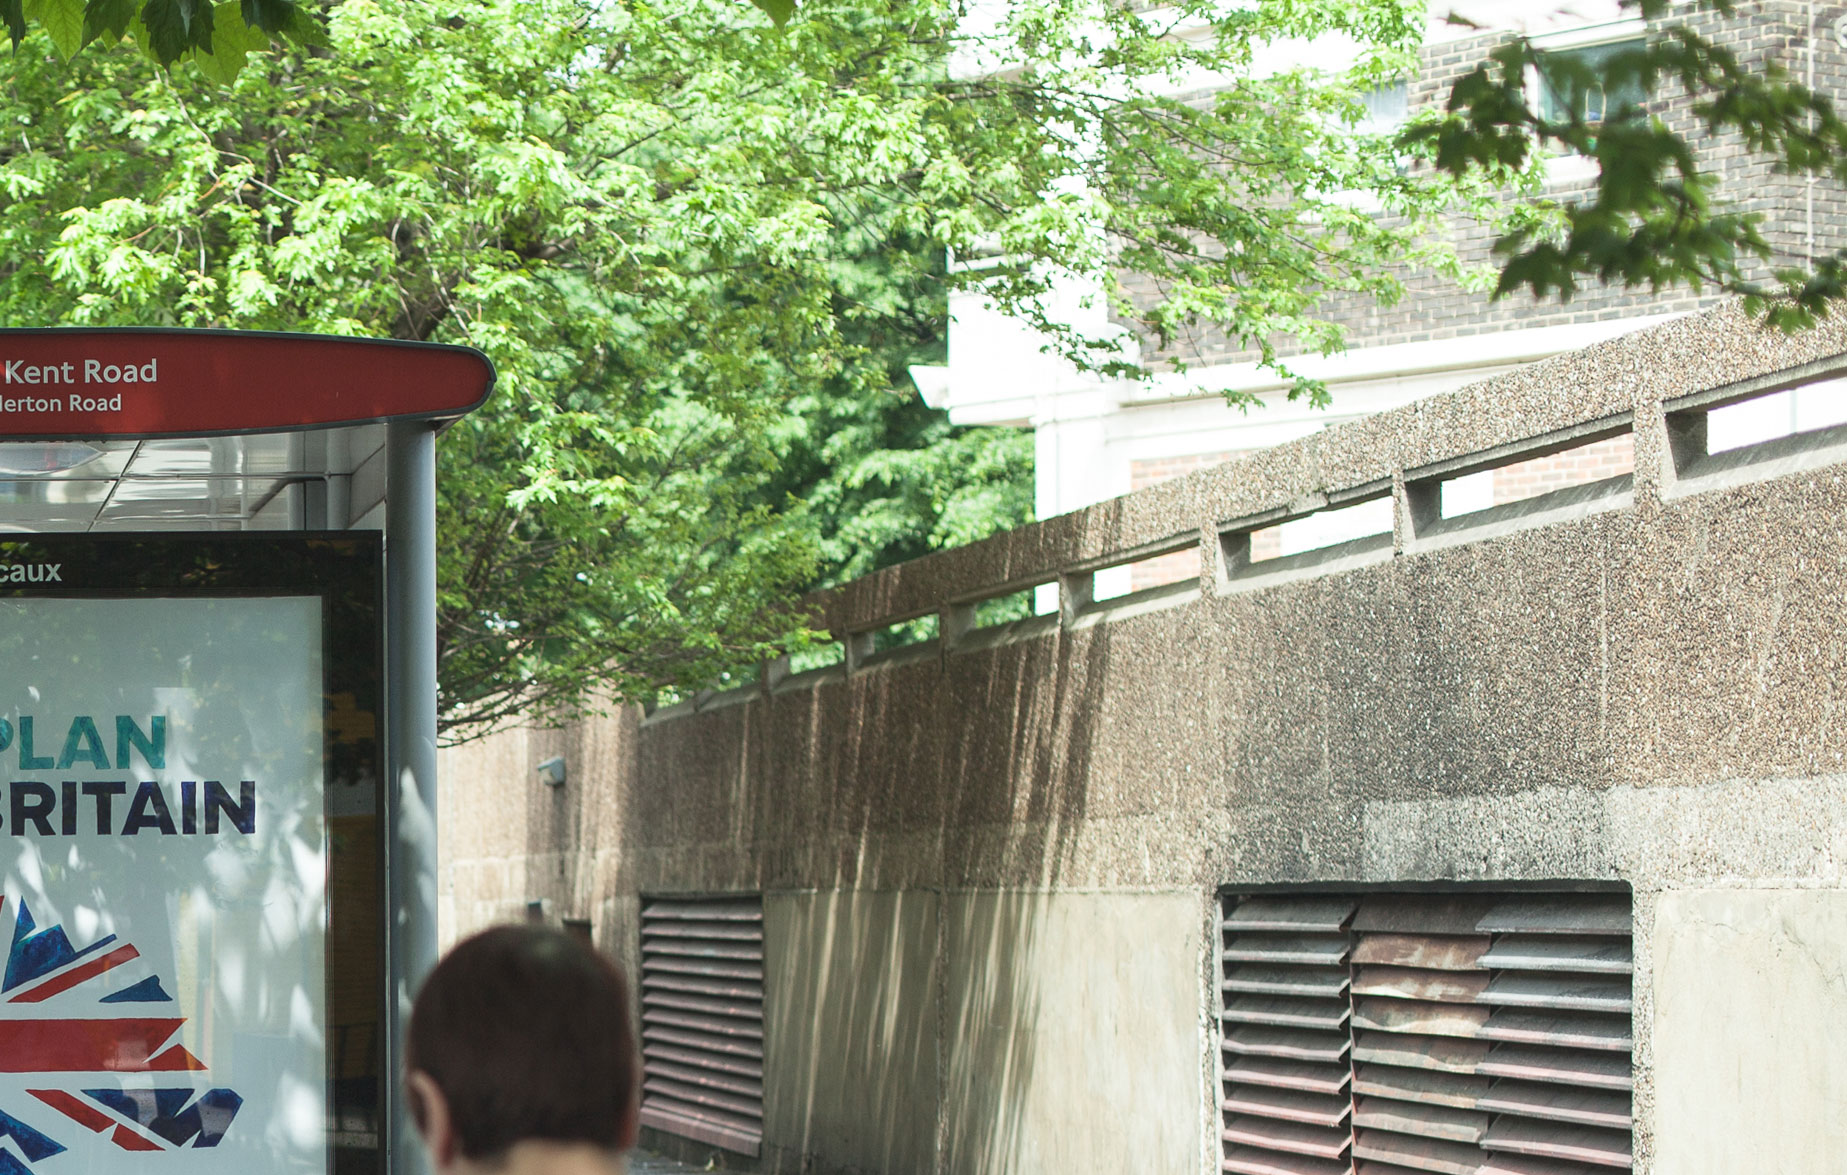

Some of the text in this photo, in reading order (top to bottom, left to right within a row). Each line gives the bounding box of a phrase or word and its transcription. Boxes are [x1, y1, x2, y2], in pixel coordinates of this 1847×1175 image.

[5, 359, 75, 384] Kent
[84, 358, 158, 383] Road
[69, 394, 121, 412] Road
